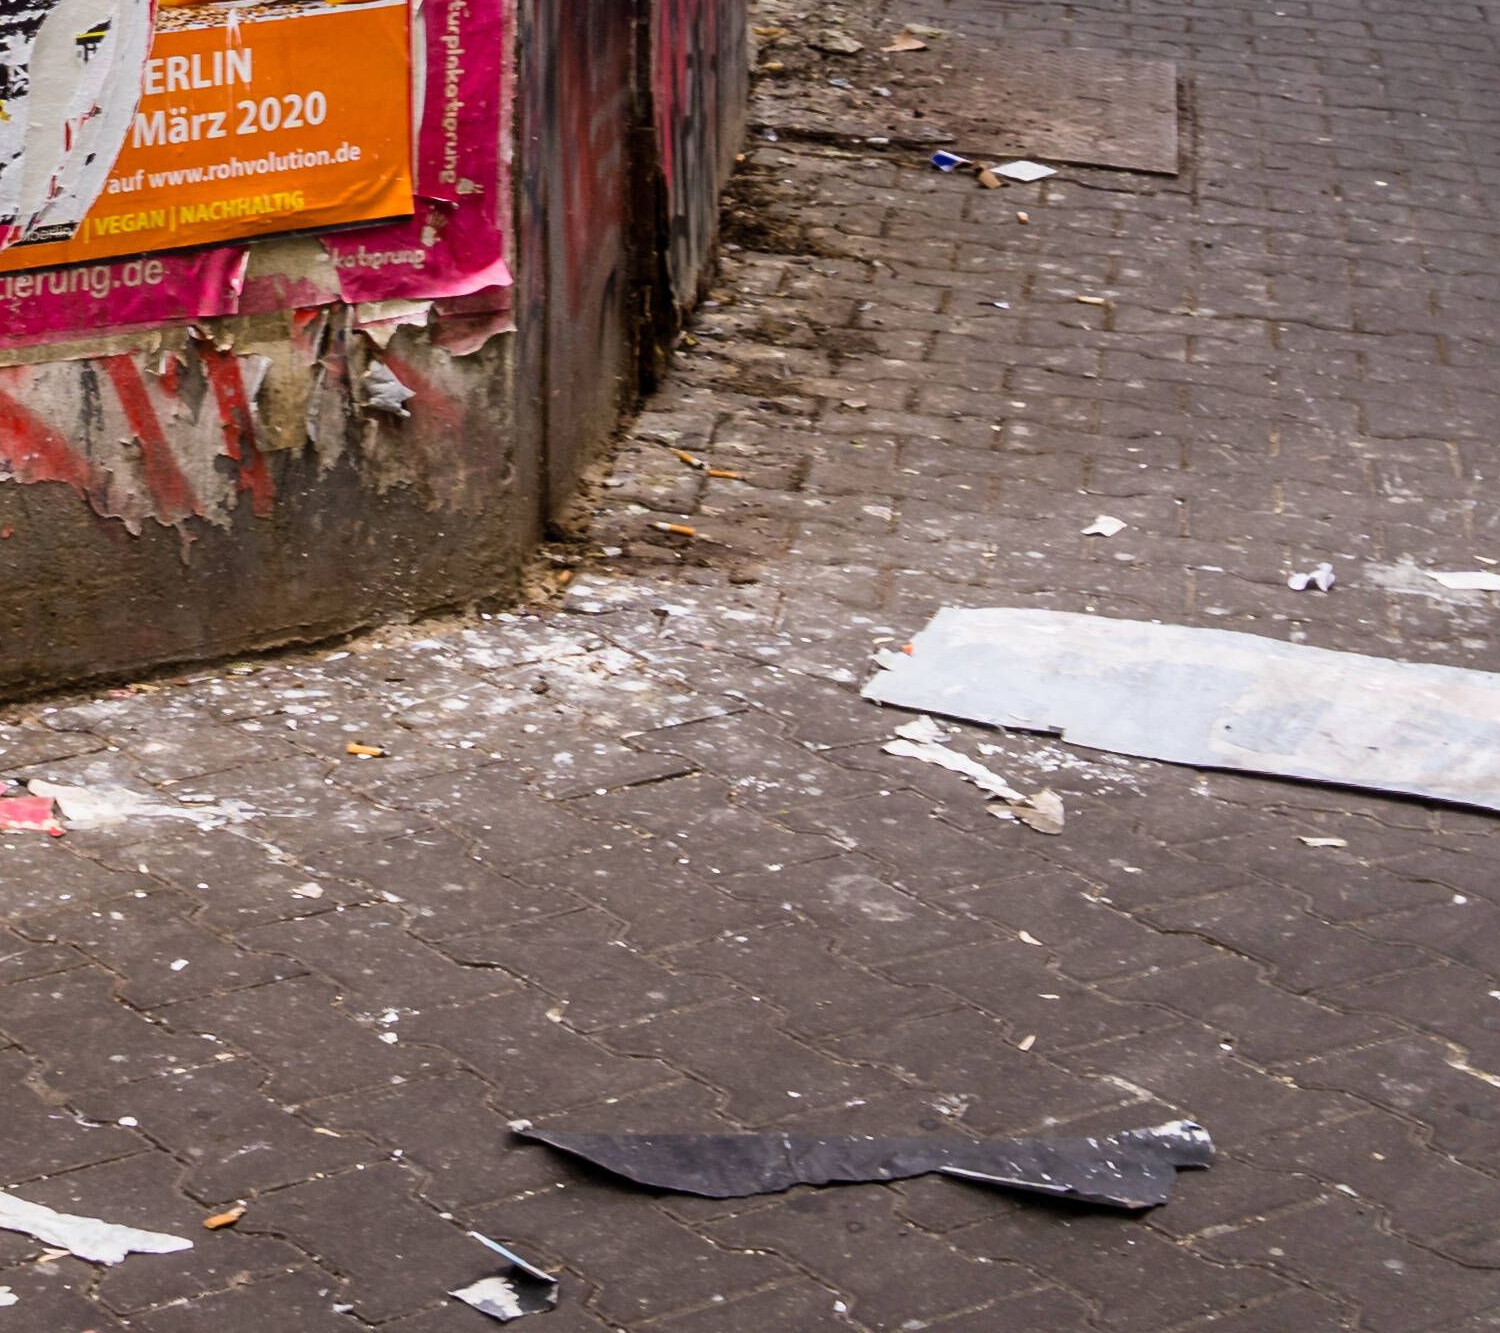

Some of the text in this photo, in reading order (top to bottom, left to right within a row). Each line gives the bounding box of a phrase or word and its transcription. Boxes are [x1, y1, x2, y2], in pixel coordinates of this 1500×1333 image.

[142, 47, 253, 95] ERLIN
[132, 90, 327, 149] März 2020
[148, 143, 361, 189] www.rohvolution.de
[96, 209, 165, 237] VEGAN
[180, 191, 305, 225] NACHHALTIG
